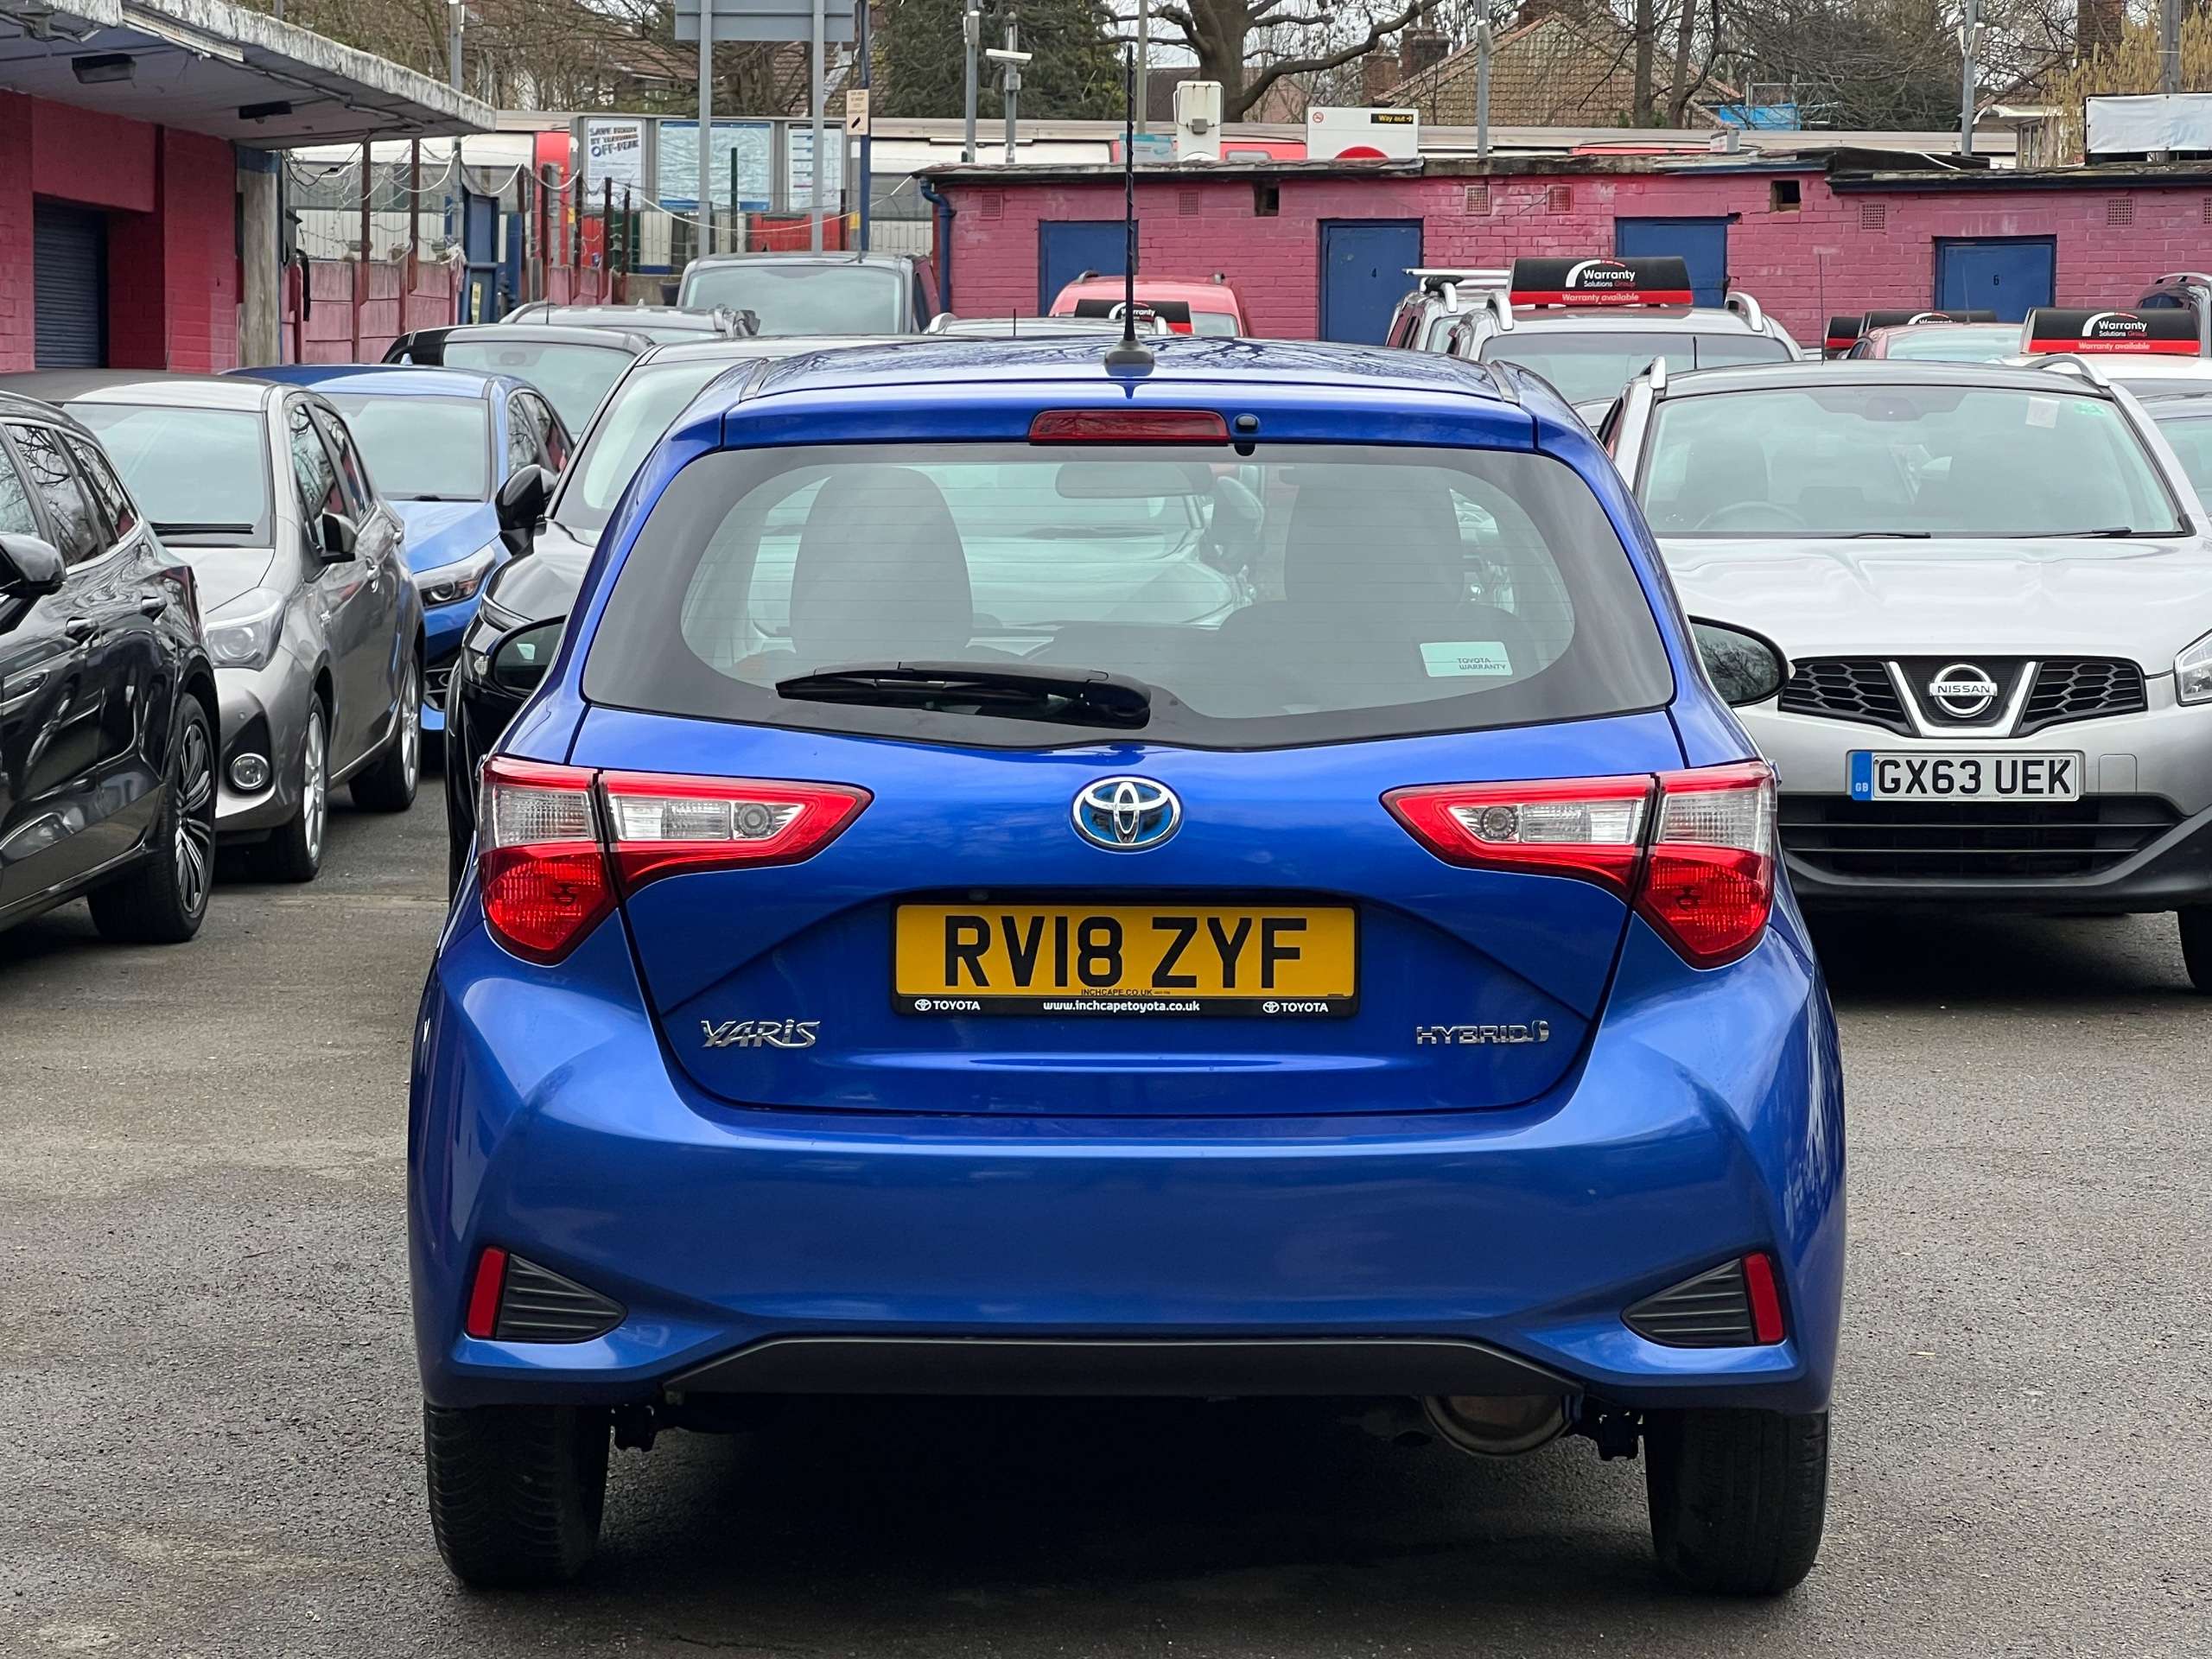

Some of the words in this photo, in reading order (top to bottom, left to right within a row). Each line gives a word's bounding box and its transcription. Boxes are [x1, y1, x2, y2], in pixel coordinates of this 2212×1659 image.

[1583, 270, 1636, 282] Warranty
[1993, 275, 2000, 286] 6
[1562, 293, 1599, 303] Warranty
[1601, 292, 1639, 302] available
[2099, 321, 2147, 332] Warranty
[2078, 341, 2113, 351] Warranty
[2114, 341, 2151, 350] available
[1878, 759, 1982, 794] GX63
[1995, 760, 2071, 795] UEK
[1854, 782, 1869, 792] GB
[944, 915, 1123, 988] RV18
[1151, 916, 1307, 989] ZYF
[933, 1000, 981, 1011] TOYOTA
[1043, 1000, 1200, 1014] www.inchcapetoyota.co.uk
[1281, 1001, 1329, 1013] TOYOTA
[1416, 1025, 1529, 1045] HYBRID
